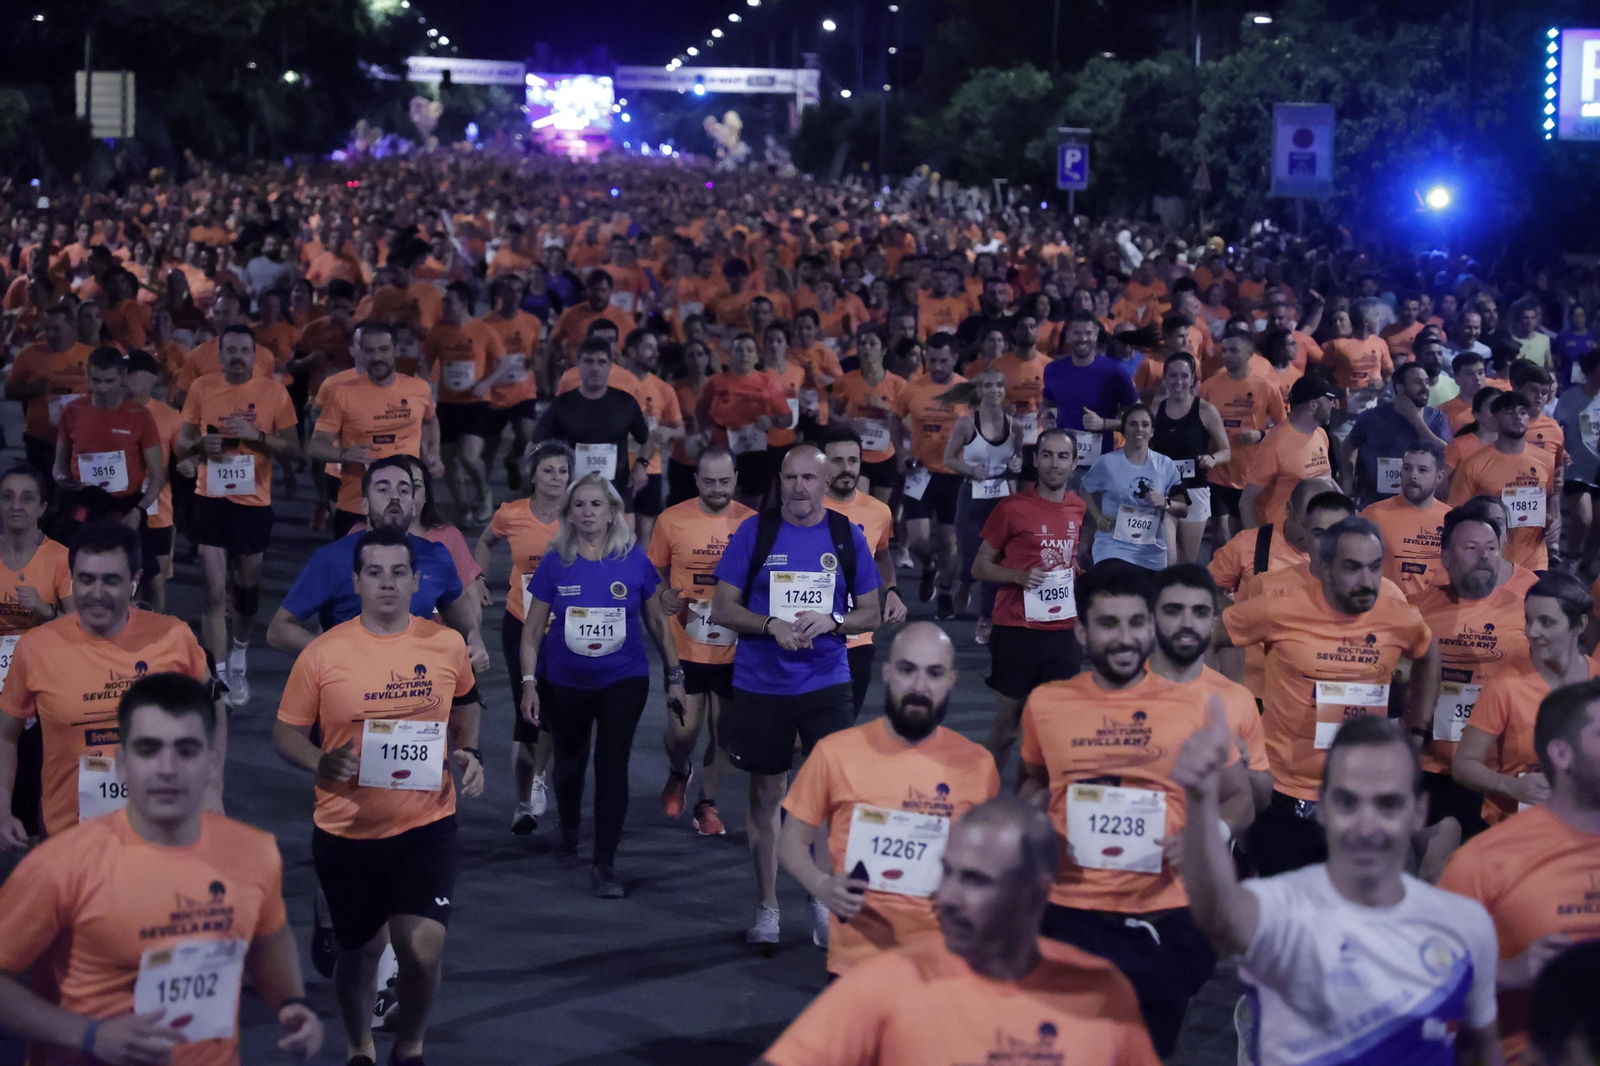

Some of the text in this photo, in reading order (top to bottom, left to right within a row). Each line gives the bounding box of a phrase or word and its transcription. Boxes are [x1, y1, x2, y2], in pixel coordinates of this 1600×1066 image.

[1065, 149, 1082, 169] P
[92, 465, 116, 477] 3616
[217, 468, 246, 479] 12113
[1510, 500, 1538, 511] 15812
[1127, 518, 1152, 530] 12602
[785, 589, 823, 604] 17423
[1037, 586, 1069, 602] 12950
[579, 624, 614, 637] 17411
[1439, 638, 1475, 648] SEVILLA
[1457, 632, 1498, 642] NOCTURNA
[1316, 652, 1356, 662] SEVILLA
[1337, 646, 1381, 656] NOCTURNA
[385, 680, 432, 691] NOCTURNA
[364, 689, 407, 701] SEVILLA
[381, 743, 428, 761] 11538
[1089, 813, 1146, 837] 12238
[871, 835, 928, 861] 12267
[157, 971, 219, 1003] 15702
